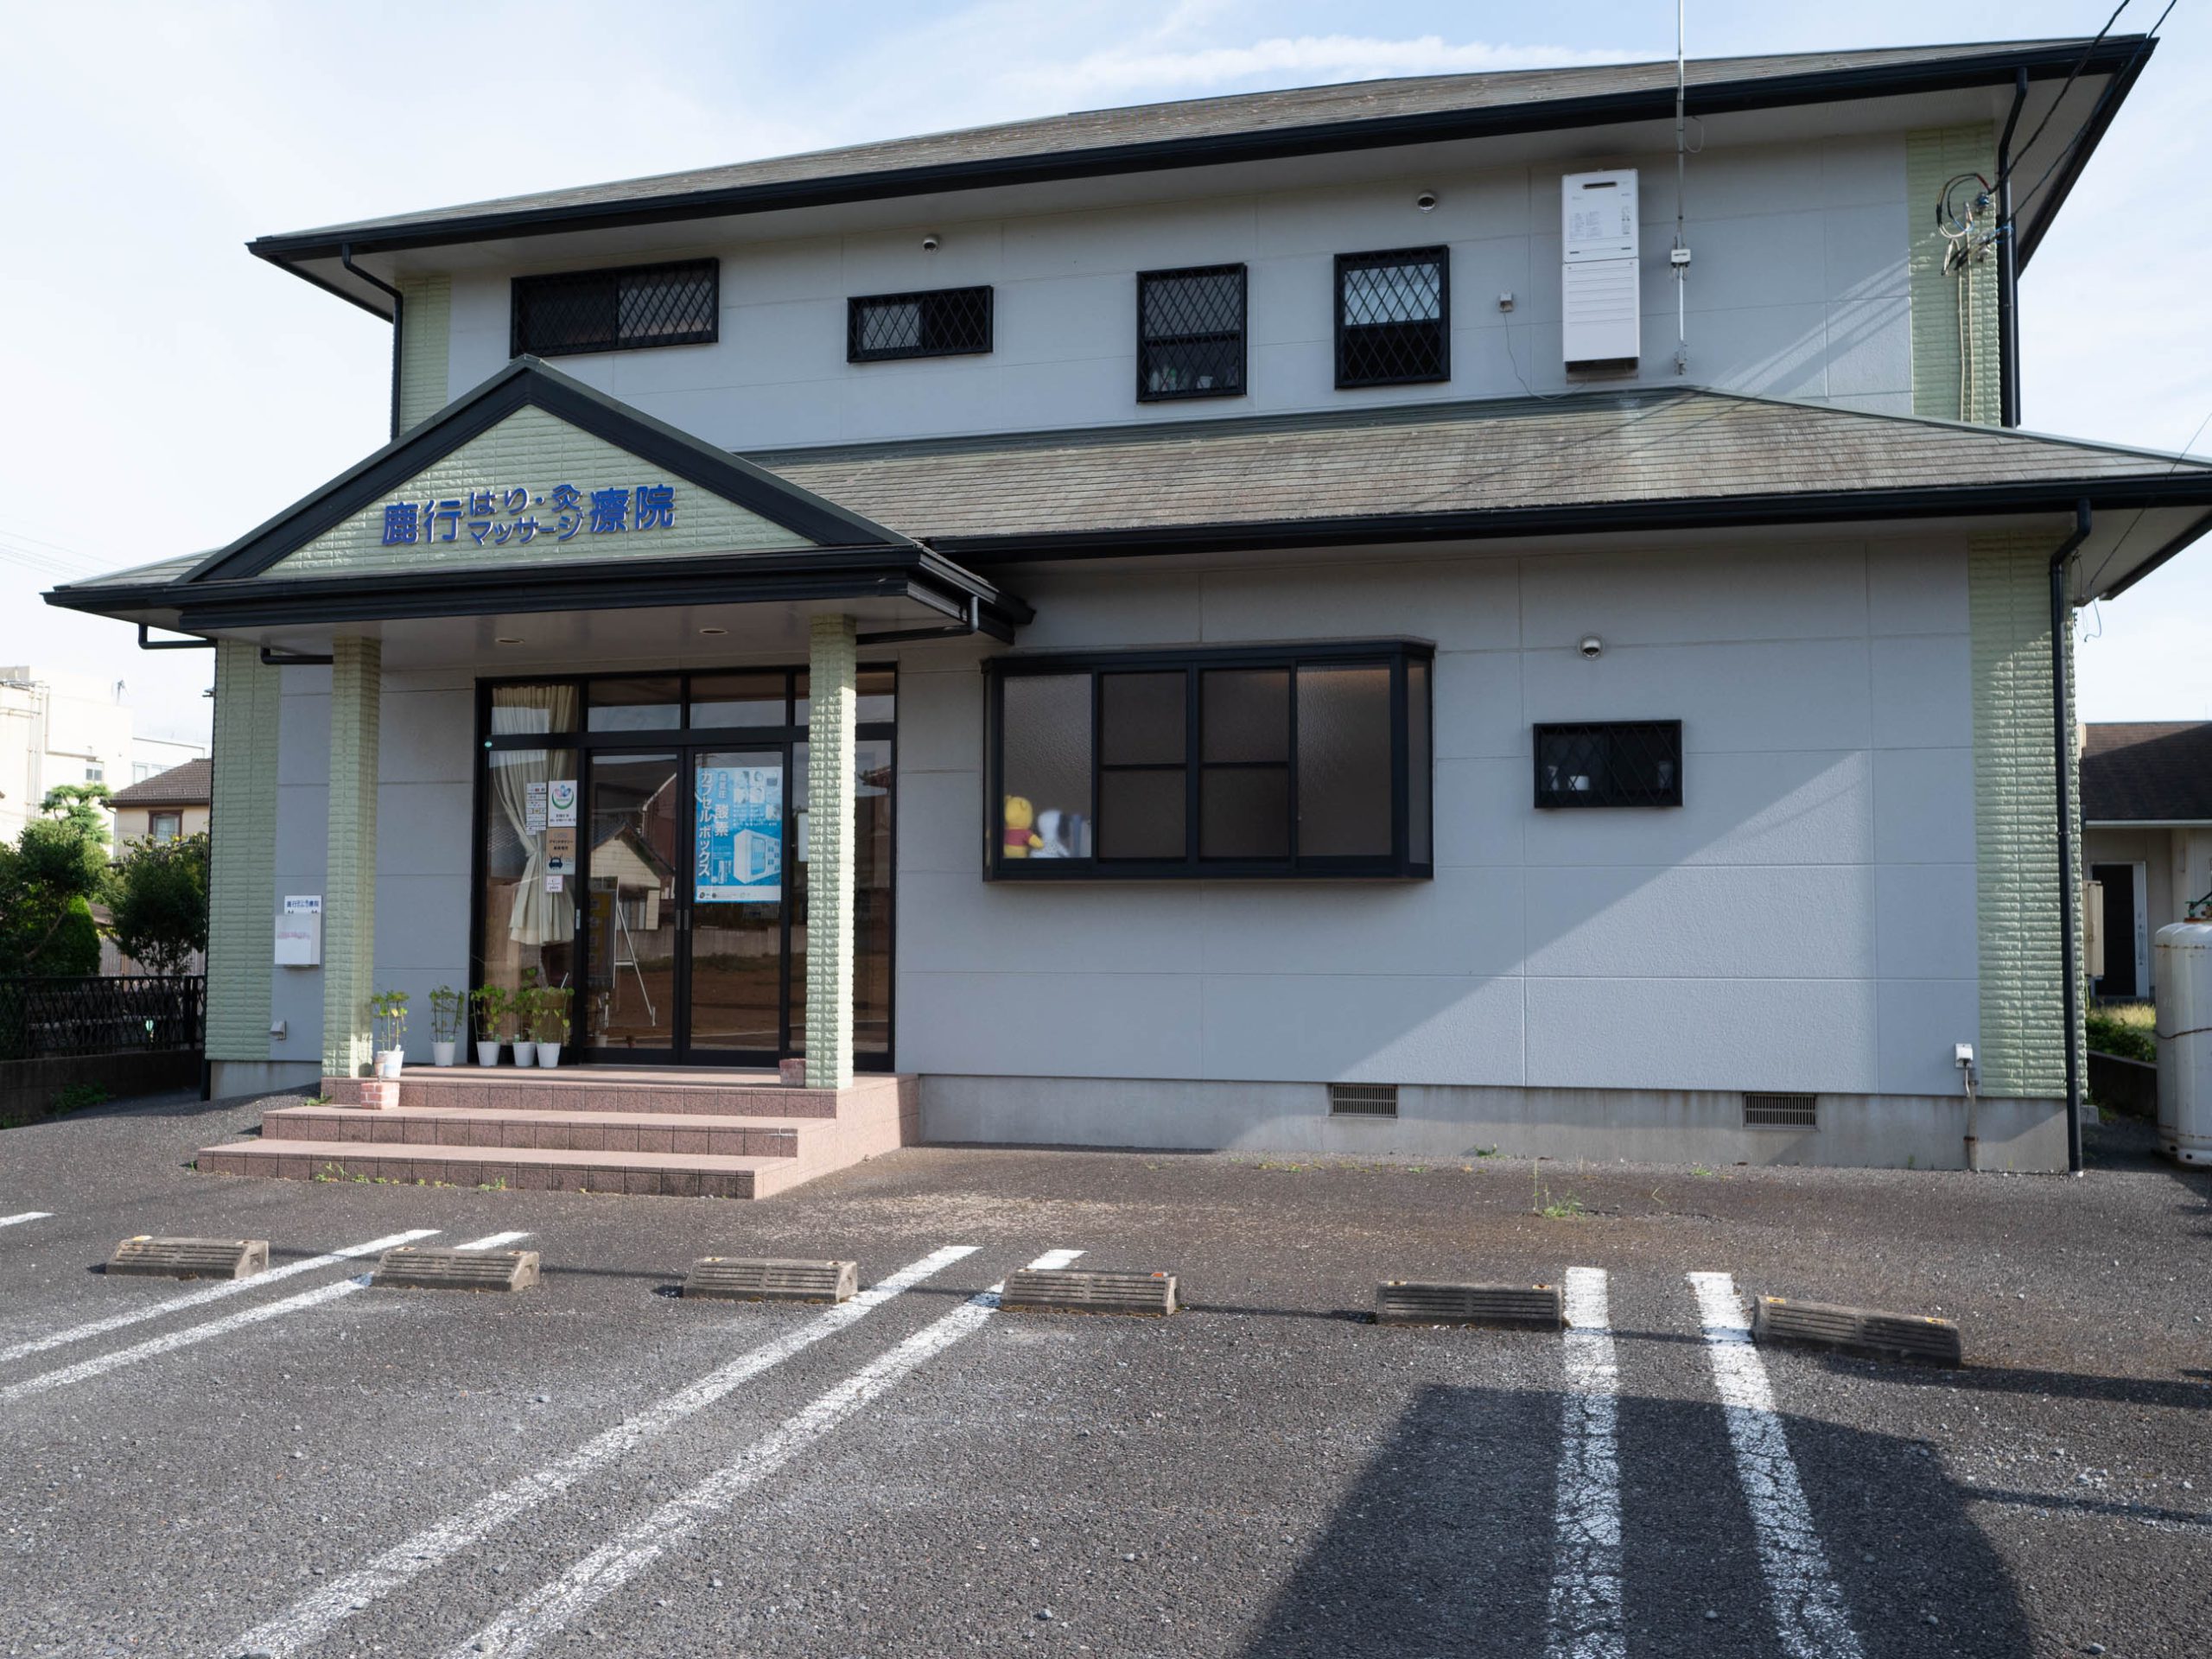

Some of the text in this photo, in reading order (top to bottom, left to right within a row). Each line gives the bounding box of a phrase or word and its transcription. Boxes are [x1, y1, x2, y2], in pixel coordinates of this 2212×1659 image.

[382, 484, 677, 546] 鹿行 はり・灸 療院
[467, 512, 585, 545] マッサージ
[715, 804, 729, 837] 酸素
[698, 826, 711, 876] ボックス
